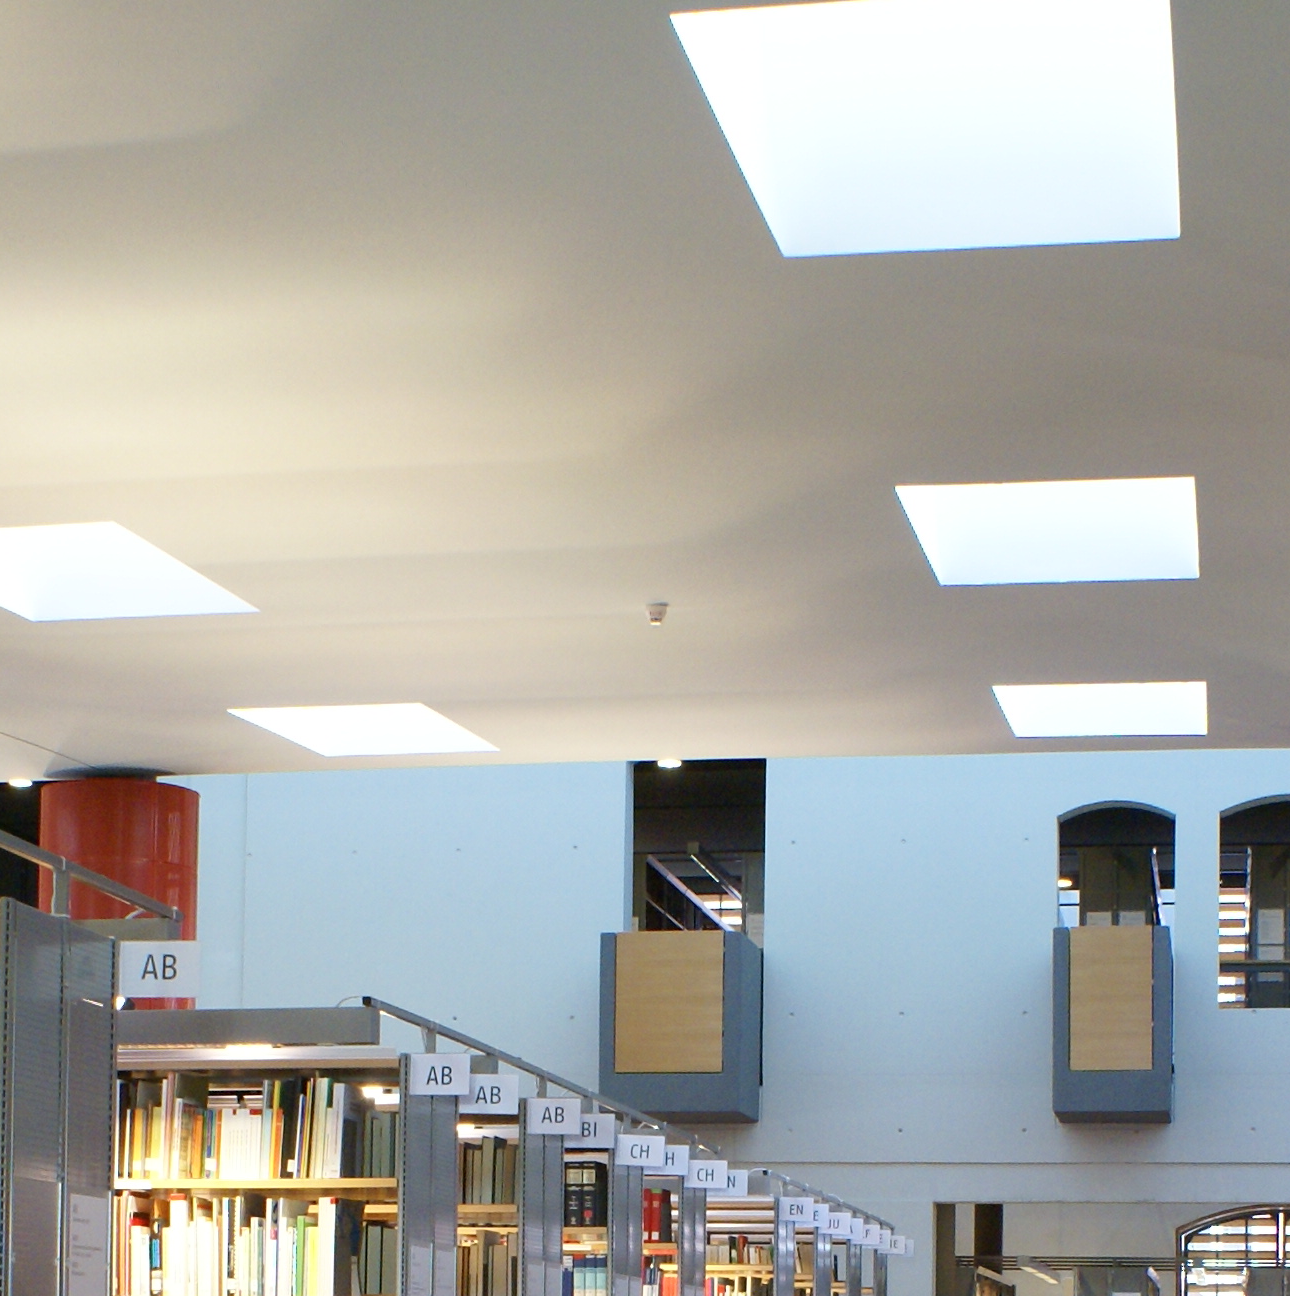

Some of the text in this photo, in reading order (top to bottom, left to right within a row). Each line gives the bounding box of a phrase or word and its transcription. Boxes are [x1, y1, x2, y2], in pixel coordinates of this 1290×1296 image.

[141, 954, 178, 980] AB
[426, 1066, 453, 1086] AB
[475, 1086, 502, 1105] AB
[541, 1107, 565, 1124] AB
[581, 1122, 597, 1138] BI
[630, 1144, 650, 1159] CH
[665, 1152, 675, 1166] H
[697, 1168, 714, 1182] CH
[728, 1176, 736, 1188] N
[789, 1204, 804, 1216] EN
[813, 1210, 819, 1221] E
